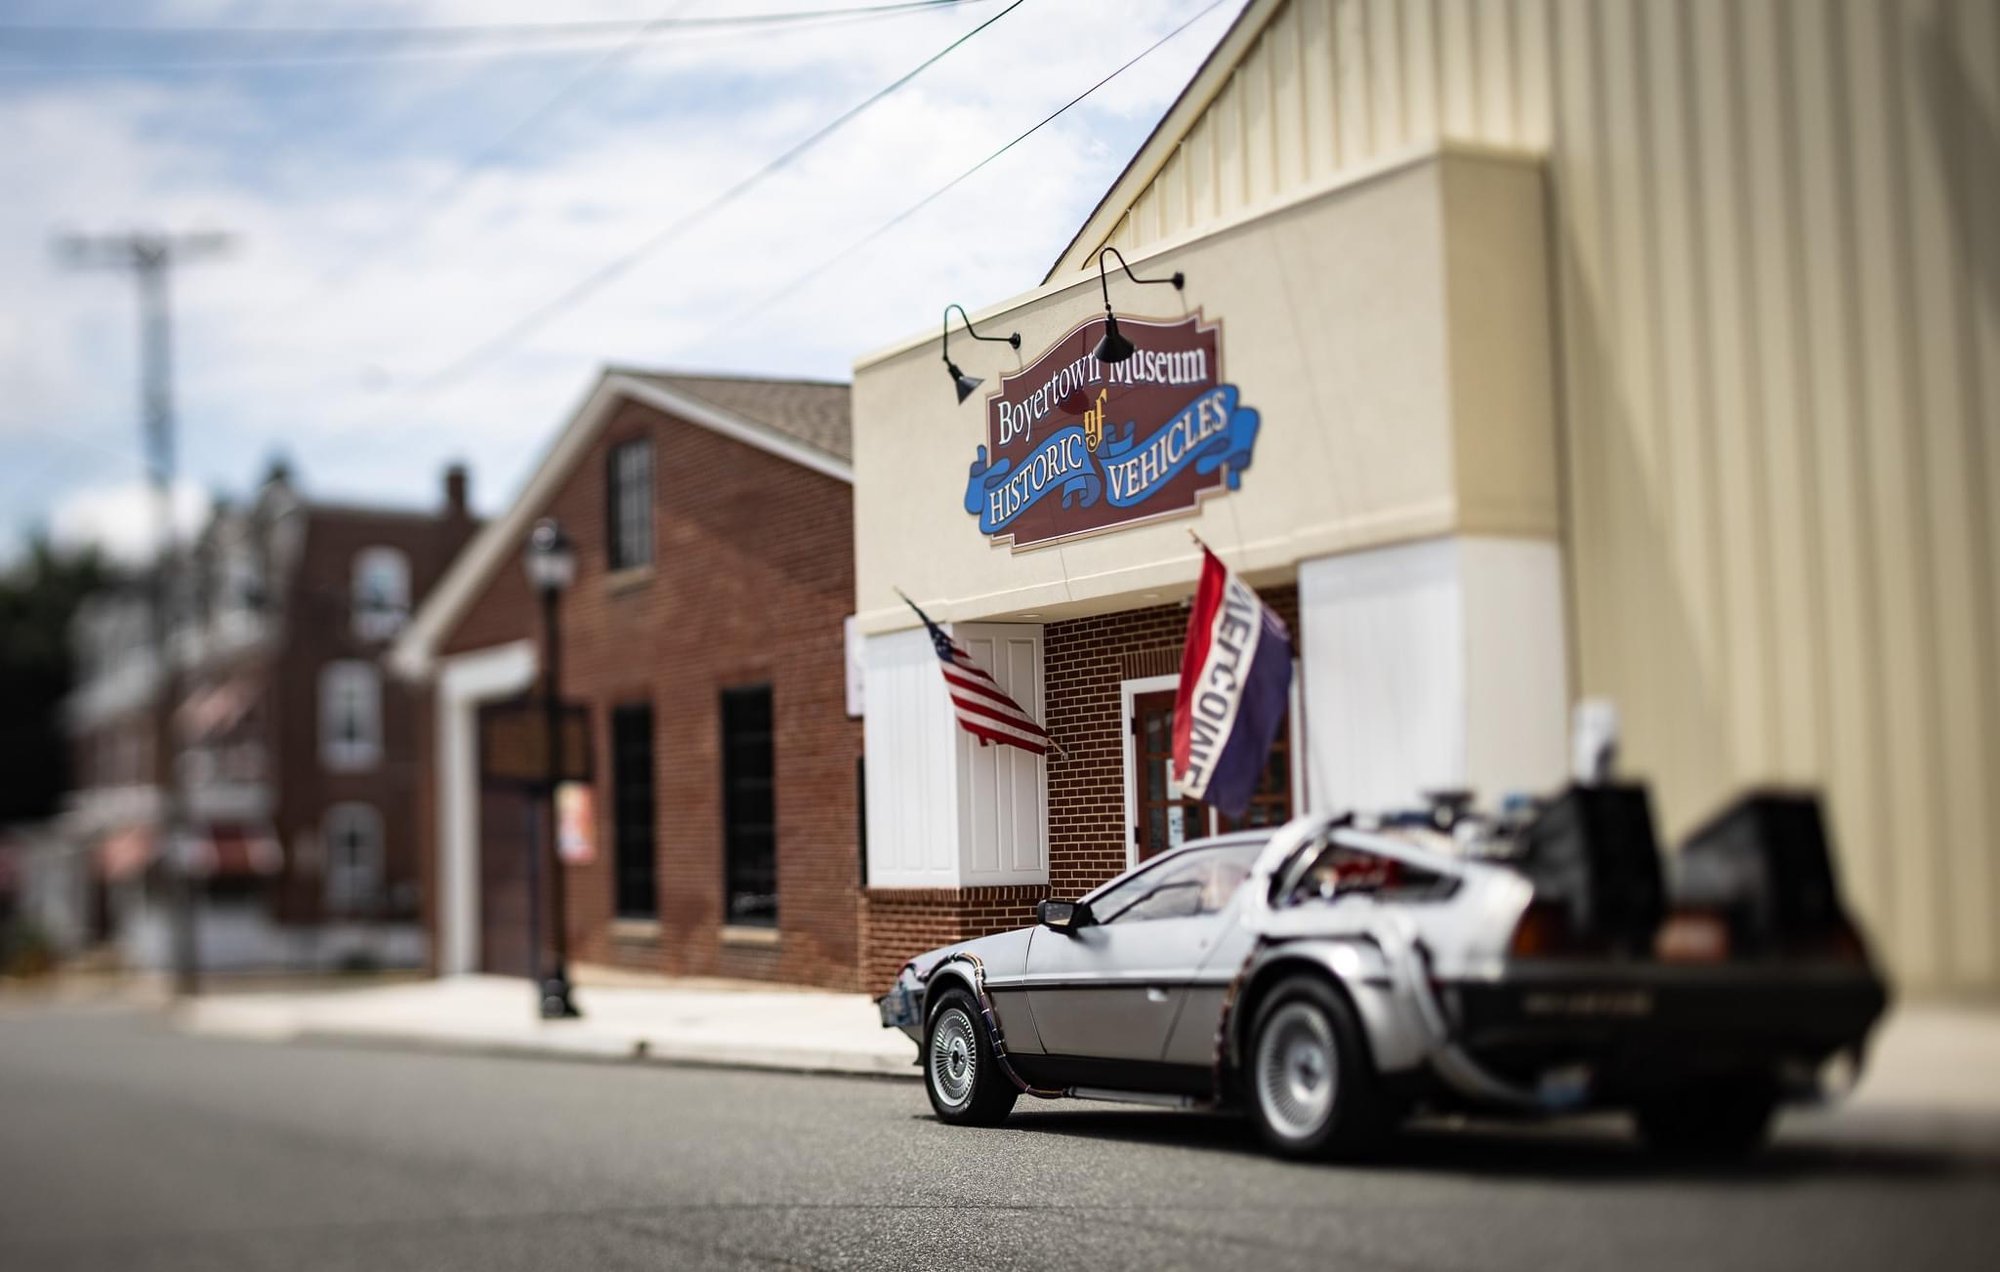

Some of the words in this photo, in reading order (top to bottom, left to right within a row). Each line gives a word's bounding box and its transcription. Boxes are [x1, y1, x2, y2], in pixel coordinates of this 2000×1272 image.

[998, 351, 1102, 445] Boyertown
[1108, 348, 1207, 385] Museum
[1083, 388, 1107, 452] of
[989, 433, 1084, 525] HISTORIC
[1107, 391, 1228, 500] VEHICLES
